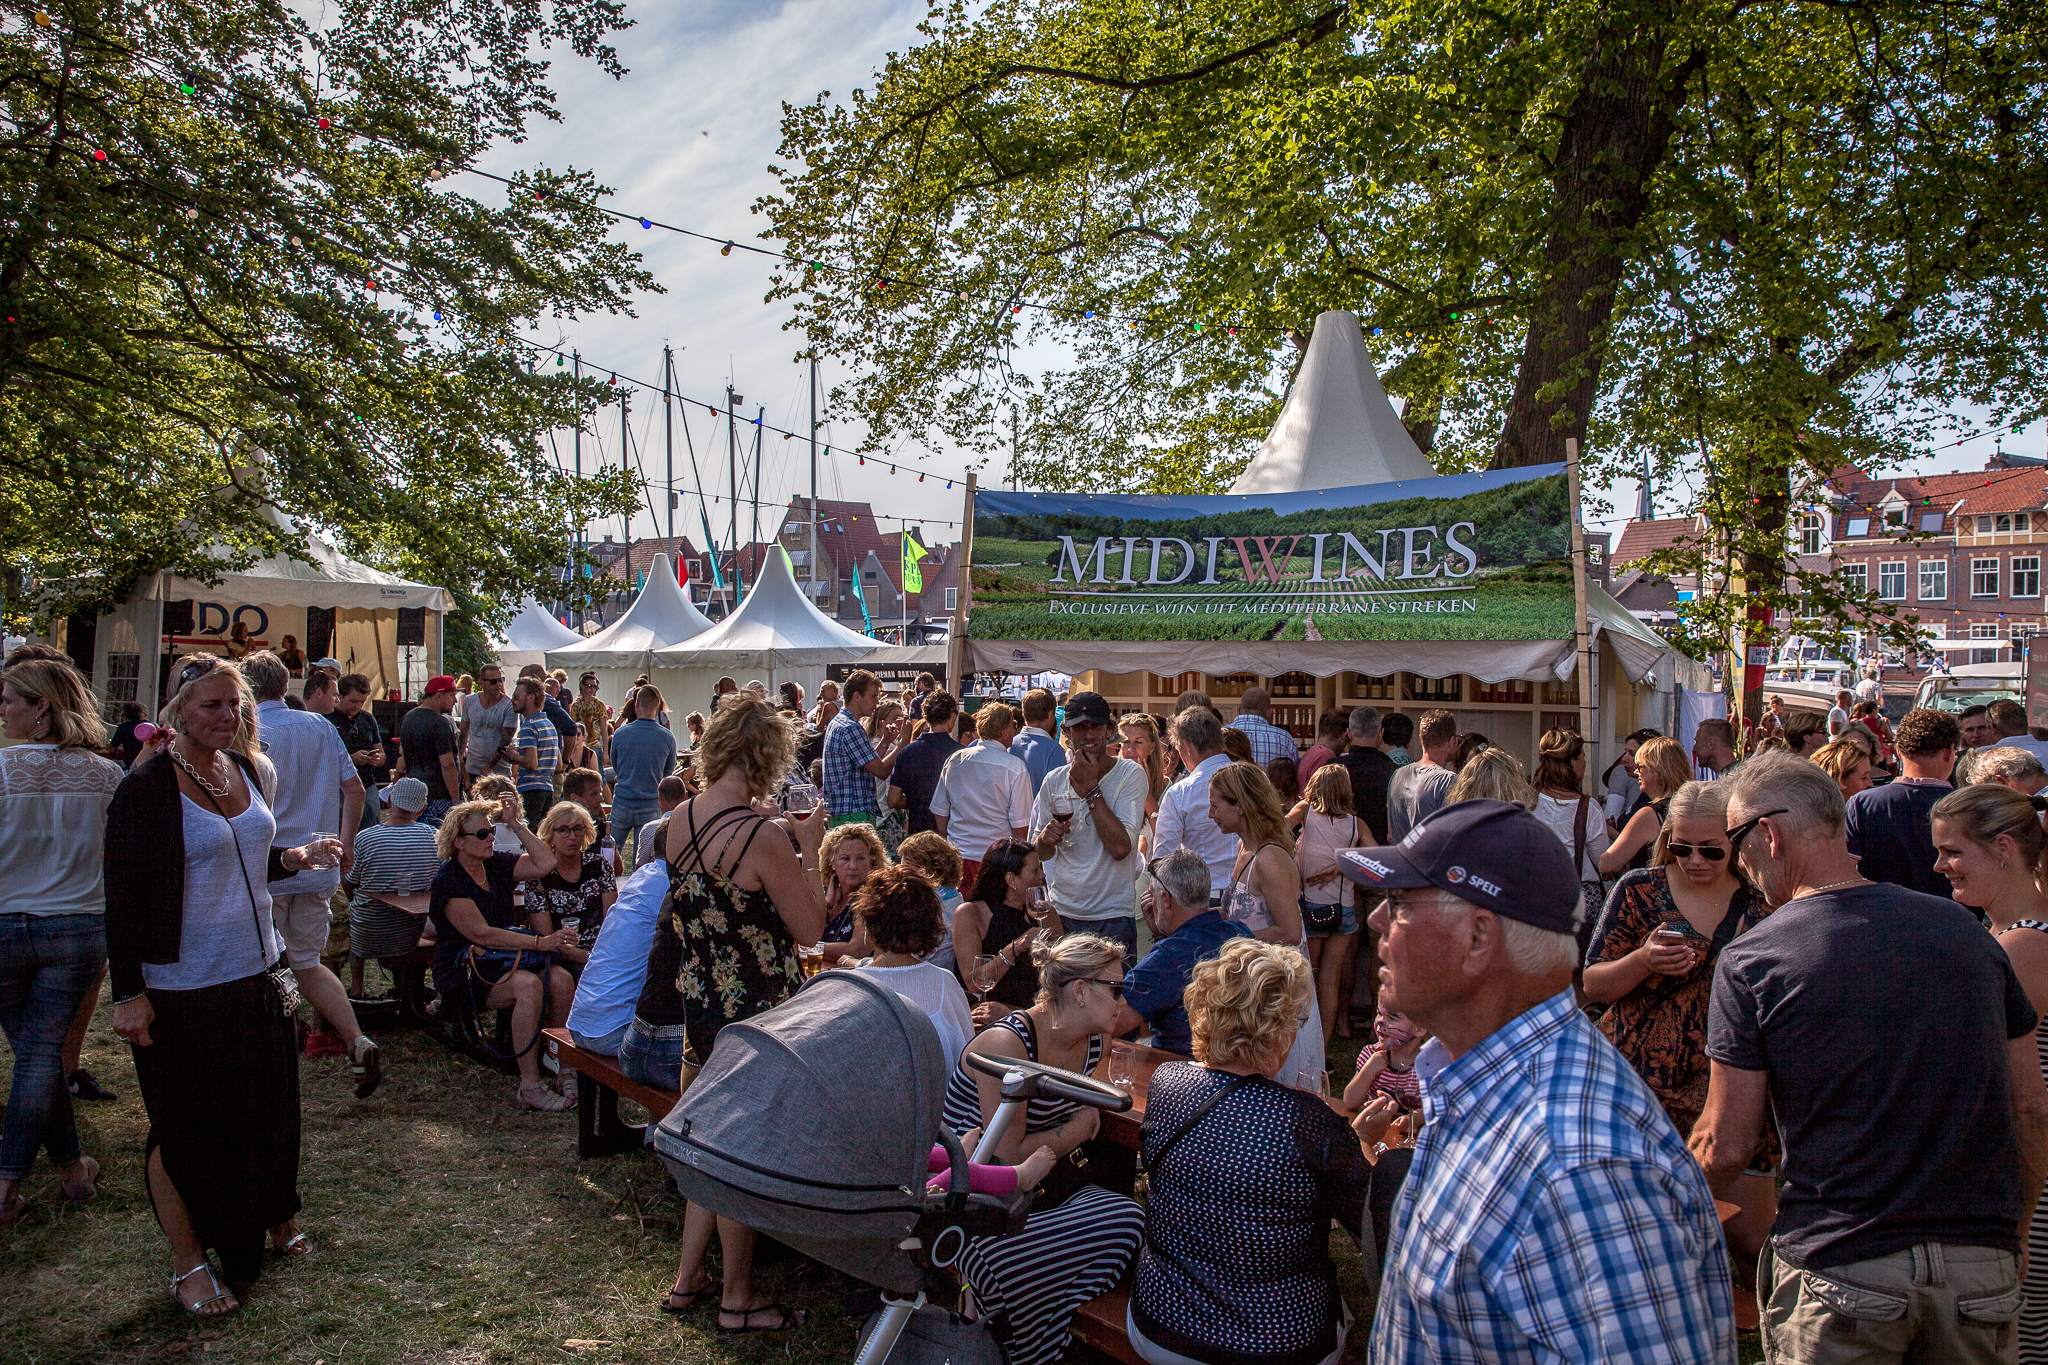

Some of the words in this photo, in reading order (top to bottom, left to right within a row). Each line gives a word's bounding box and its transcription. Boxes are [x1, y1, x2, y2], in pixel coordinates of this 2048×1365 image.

[1049, 522, 1478, 585] MIDIWINES
[191, 602, 269, 637] DO
[1048, 600, 1150, 616] EXCLUSIEVE
[1155, 603, 1200, 615] WIJN
[1205, 603, 1238, 614] UIT
[1241, 602, 1381, 614] MEDITERRANE
[1386, 598, 1477, 614] STREKEN
[1468, 875, 1502, 897] SPELT
